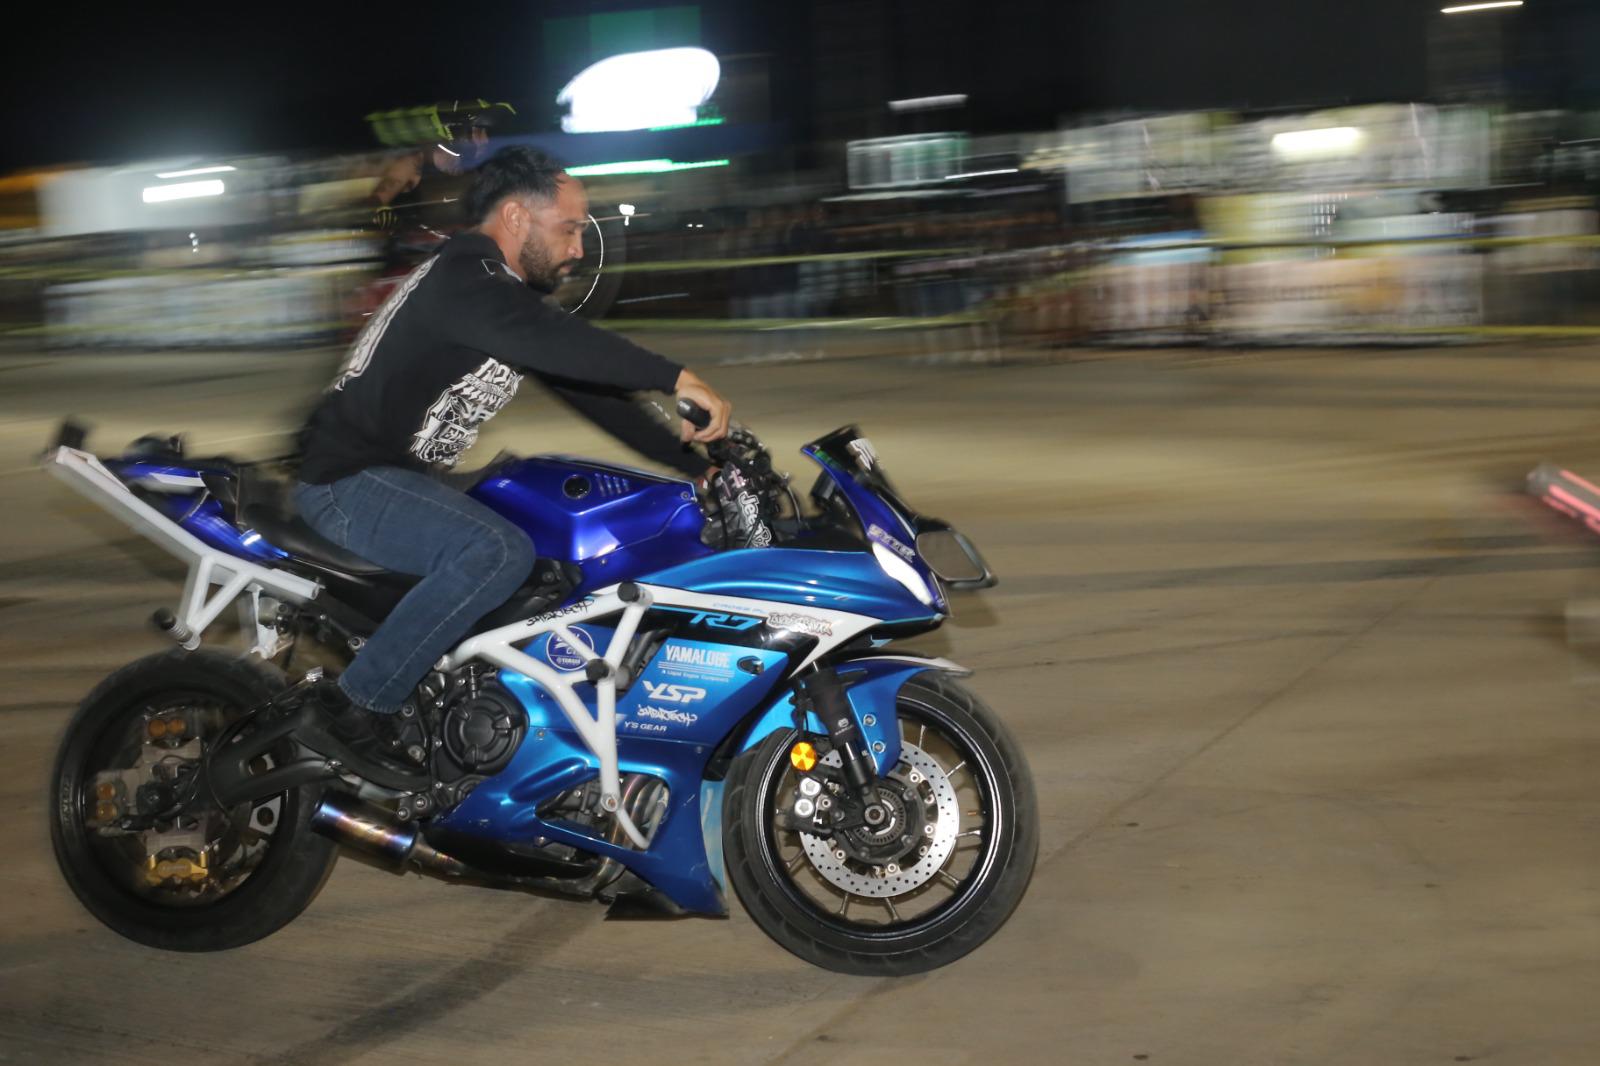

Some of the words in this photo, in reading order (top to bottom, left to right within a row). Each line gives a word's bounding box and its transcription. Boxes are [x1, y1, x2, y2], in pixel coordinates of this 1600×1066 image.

[666, 644, 731, 668] YAMALUBE
[642, 680, 706, 703] YSP
[640, 723, 667, 731] GEAR
